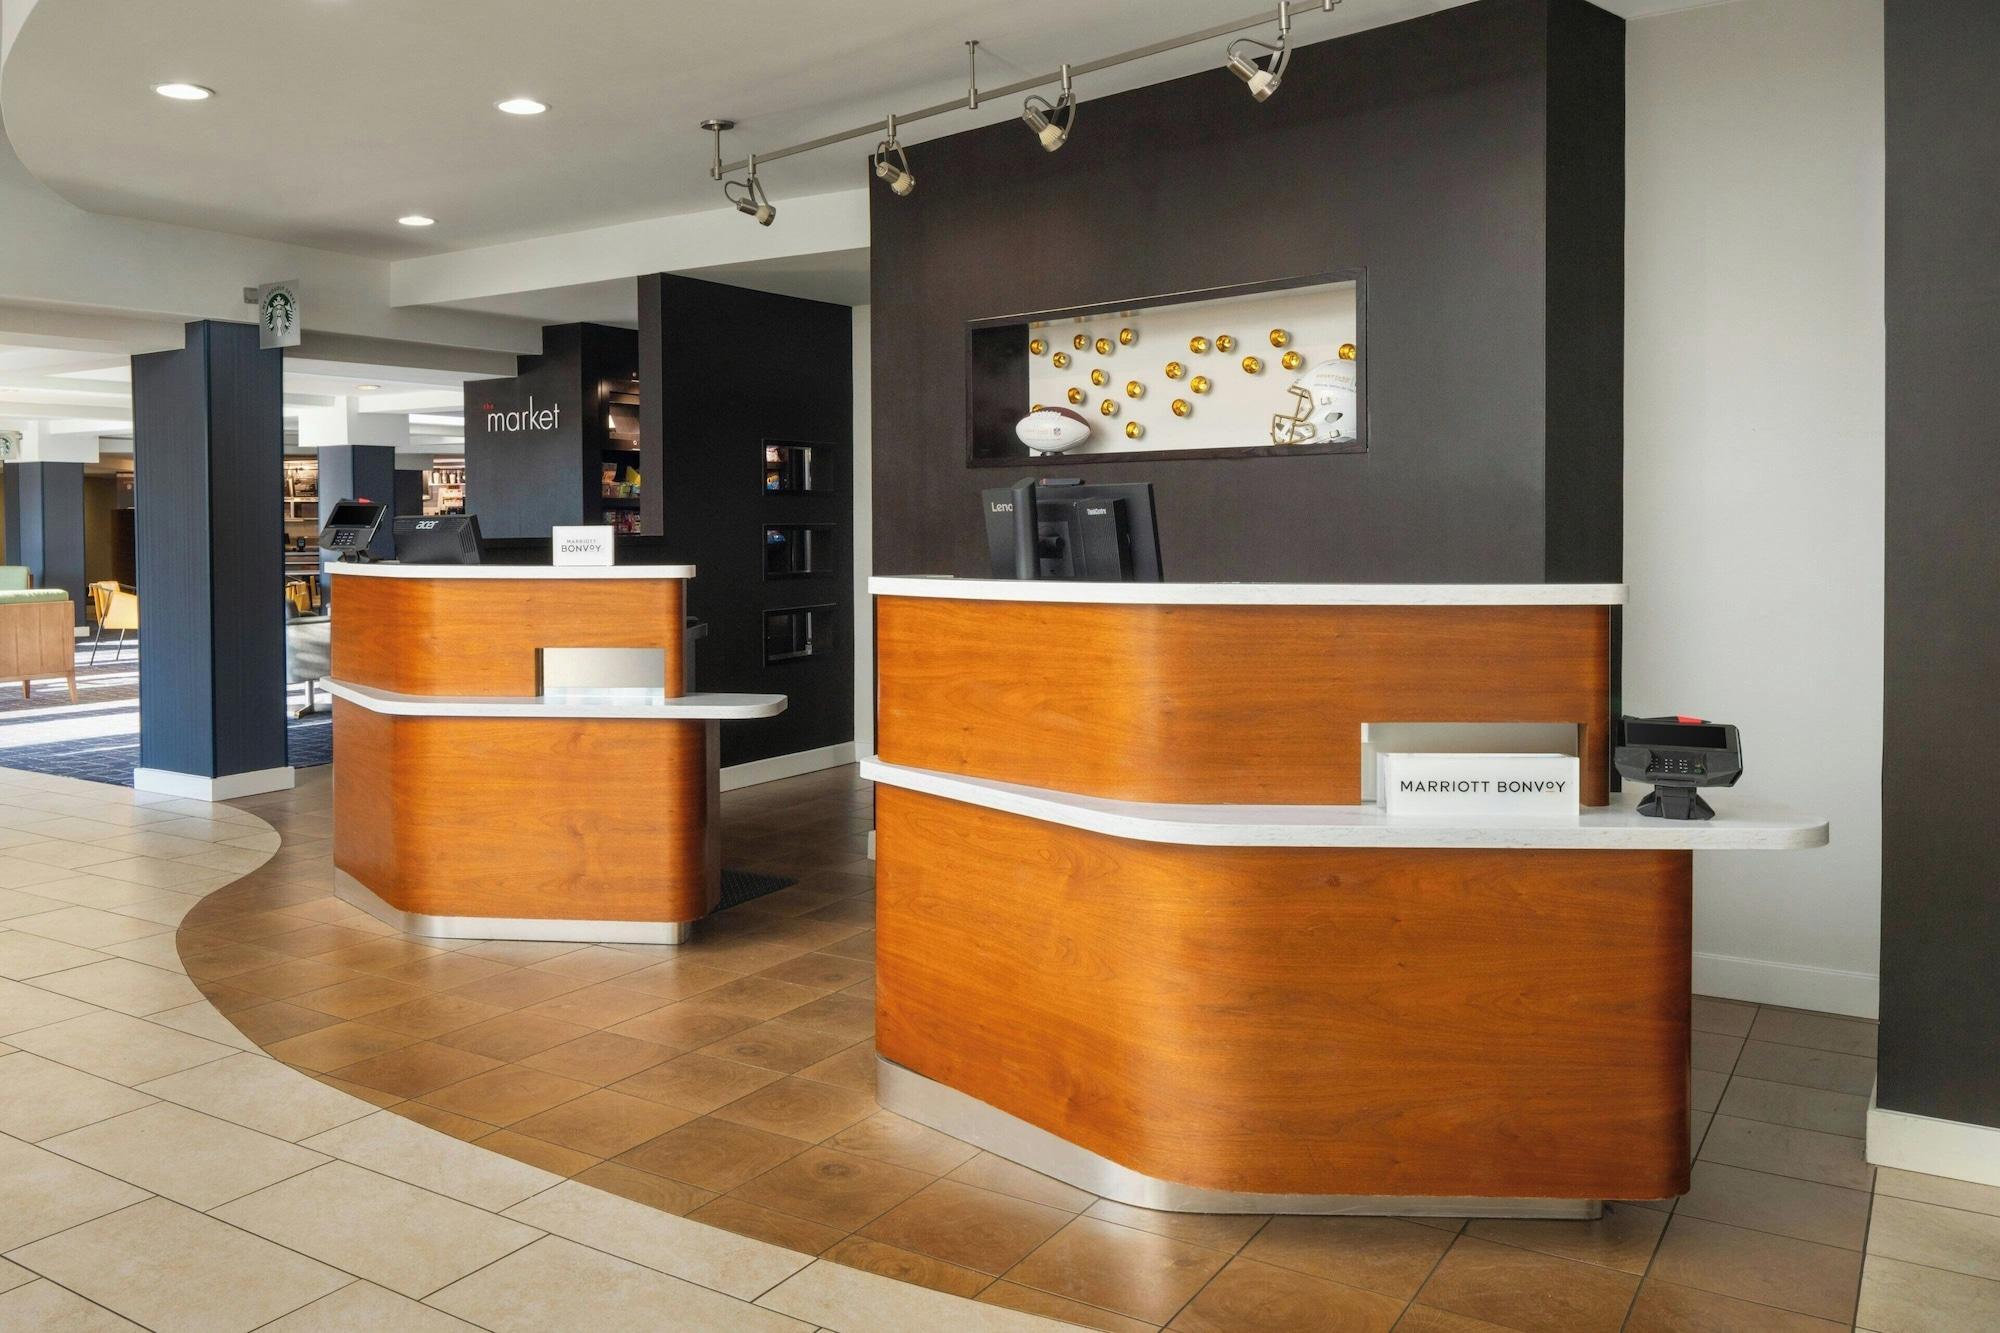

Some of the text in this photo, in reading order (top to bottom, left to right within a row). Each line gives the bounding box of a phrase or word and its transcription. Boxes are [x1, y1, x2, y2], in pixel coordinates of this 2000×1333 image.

[487, 395, 560, 432] market
[991, 502, 1013, 512] Leno
[416, 521, 439, 529] acer
[561, 544, 601, 552] BONVOY
[1400, 780, 1566, 793] MARRIOTT BONVOY
